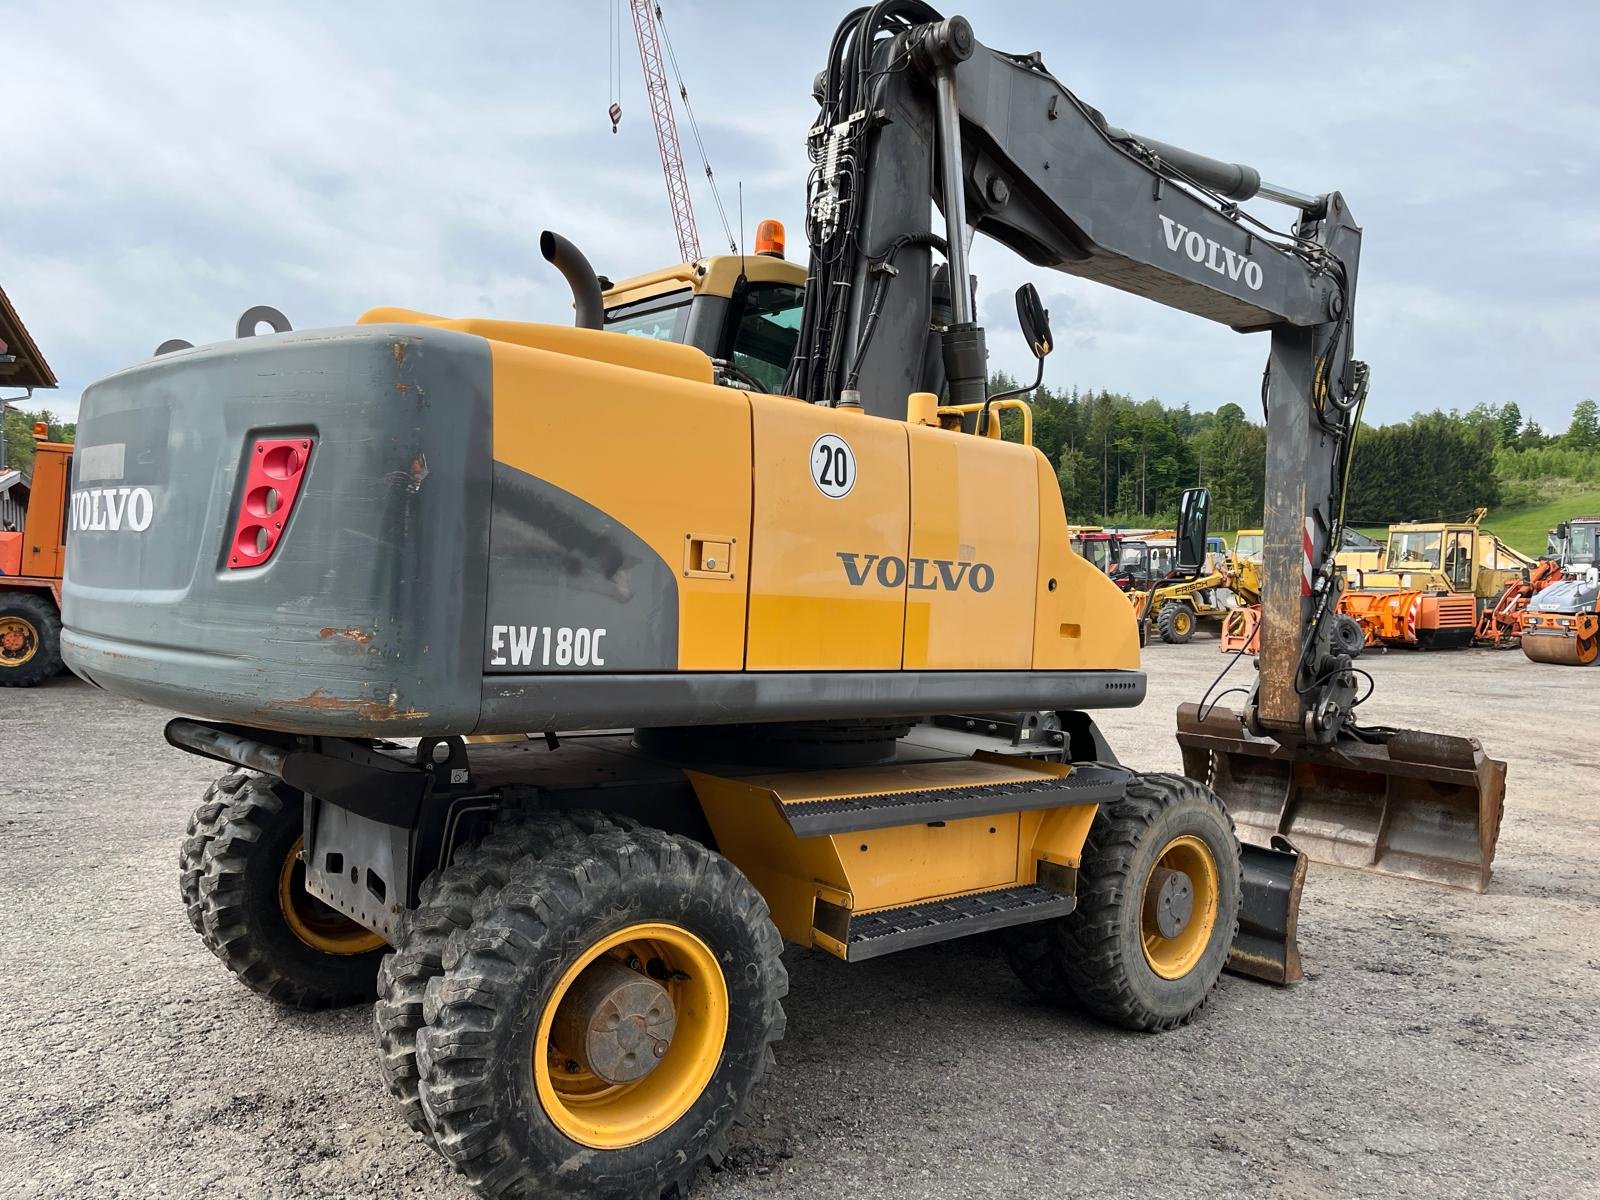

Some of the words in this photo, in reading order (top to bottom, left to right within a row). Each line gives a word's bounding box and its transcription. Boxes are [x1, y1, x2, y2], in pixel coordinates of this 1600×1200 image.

[1159, 214, 1263, 291] VOLVO
[820, 444, 847, 487] 20
[71, 487, 154, 532] VOLVO
[836, 552, 995, 593] VOLVO
[1175, 580, 1208, 594] FRISCH
[490, 625, 607, 666] EW180C
